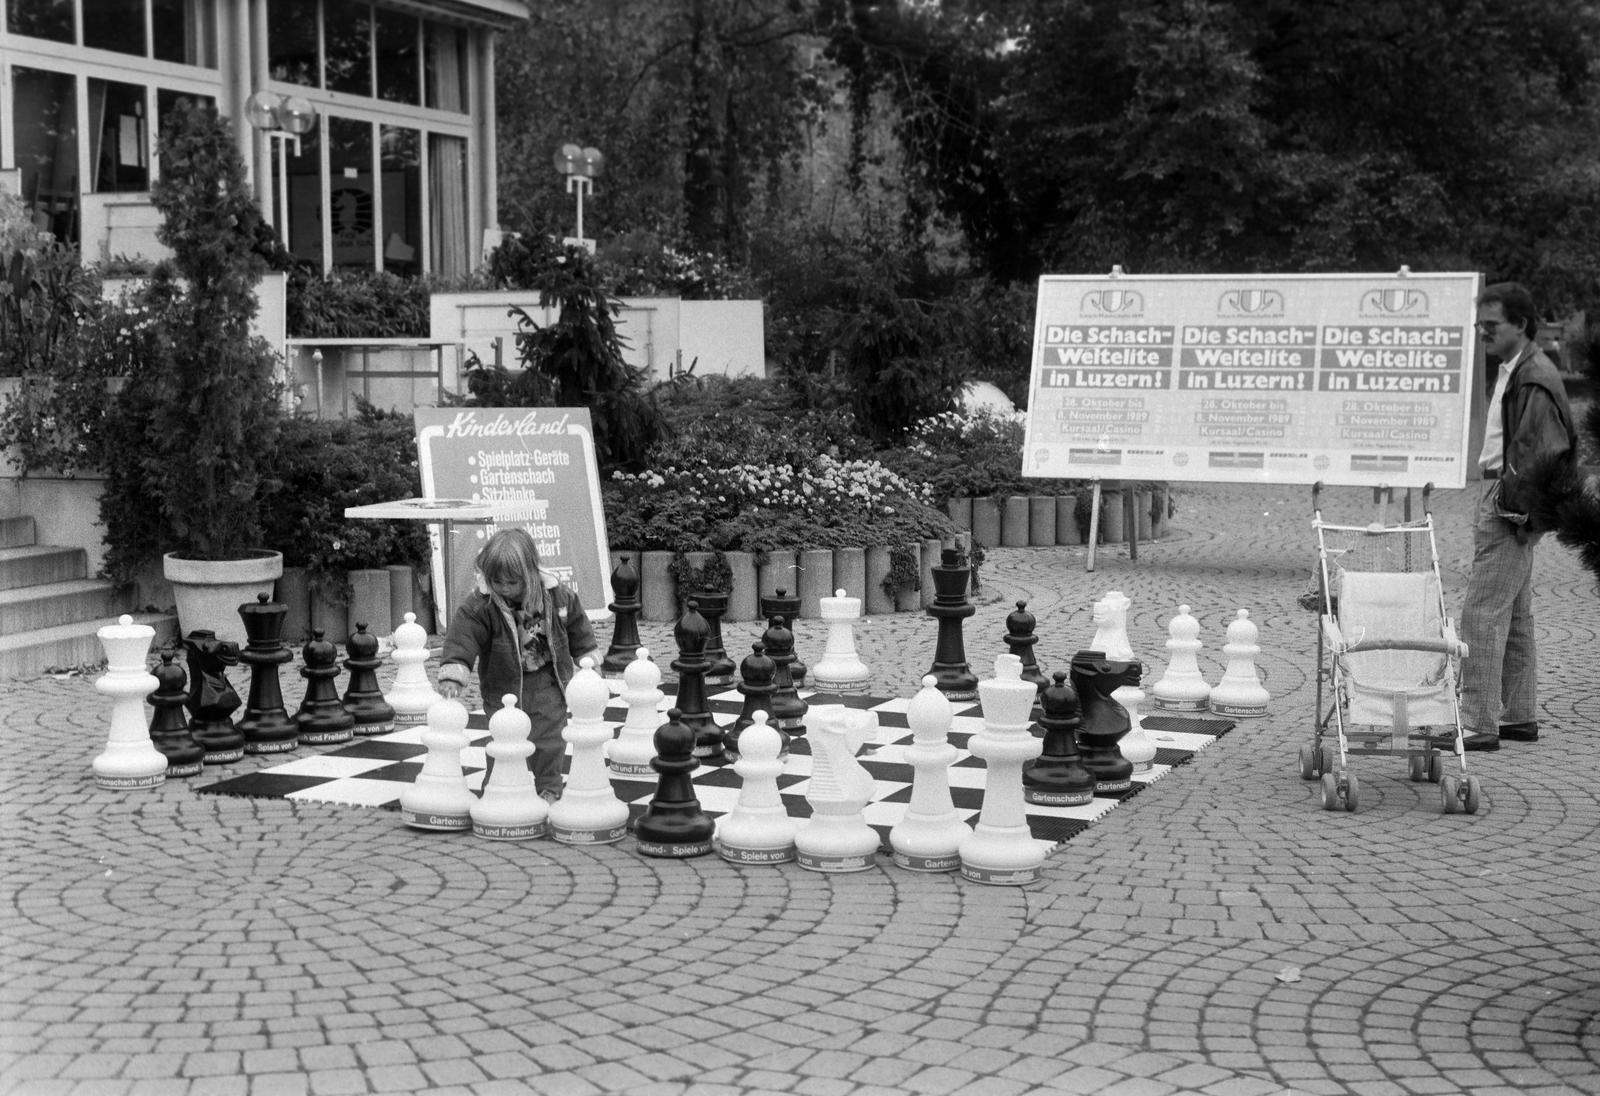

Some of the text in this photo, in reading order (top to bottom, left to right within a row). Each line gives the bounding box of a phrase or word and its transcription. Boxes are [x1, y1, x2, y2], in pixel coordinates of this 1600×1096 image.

[1047, 326, 1172, 344] Die Schach-
[1184, 327, 1314, 344] Die Schach-
[1324, 327, 1460, 345] Die Schach-
[1057, 348, 1160, 365] Weltelite
[1195, 349, 1301, 366] Weltelite
[1336, 350, 1448, 368] Weltelite
[1050, 369, 1162, 388] in Luzern!
[1187, 371, 1304, 389] in Luzern!
[1328, 372, 1450, 391] in Luzern!
[1081, 398, 1124, 409] Oktober
[1221, 400, 1266, 410] Oktober
[1364, 401, 1411, 412] Oktober
[1069, 411, 1123, 420] November
[1127, 411, 1148, 420] 1989
[1209, 413, 1264, 423] November
[1268, 413, 1290, 423] 1989
[1350, 415, 1408, 425] November
[1413, 416, 1435, 426] 1989
[446, 411, 569, 438] Kinderland
[478, 449, 570, 471] Spielplatz-Geräte
[480, 467, 555, 486] Gartenschach
[1032, 792, 1083, 803] Gartenschach
[672, 845, 698, 856] Spiele
[741, 850, 768, 862] Spiele
[770, 852, 785, 860] von
